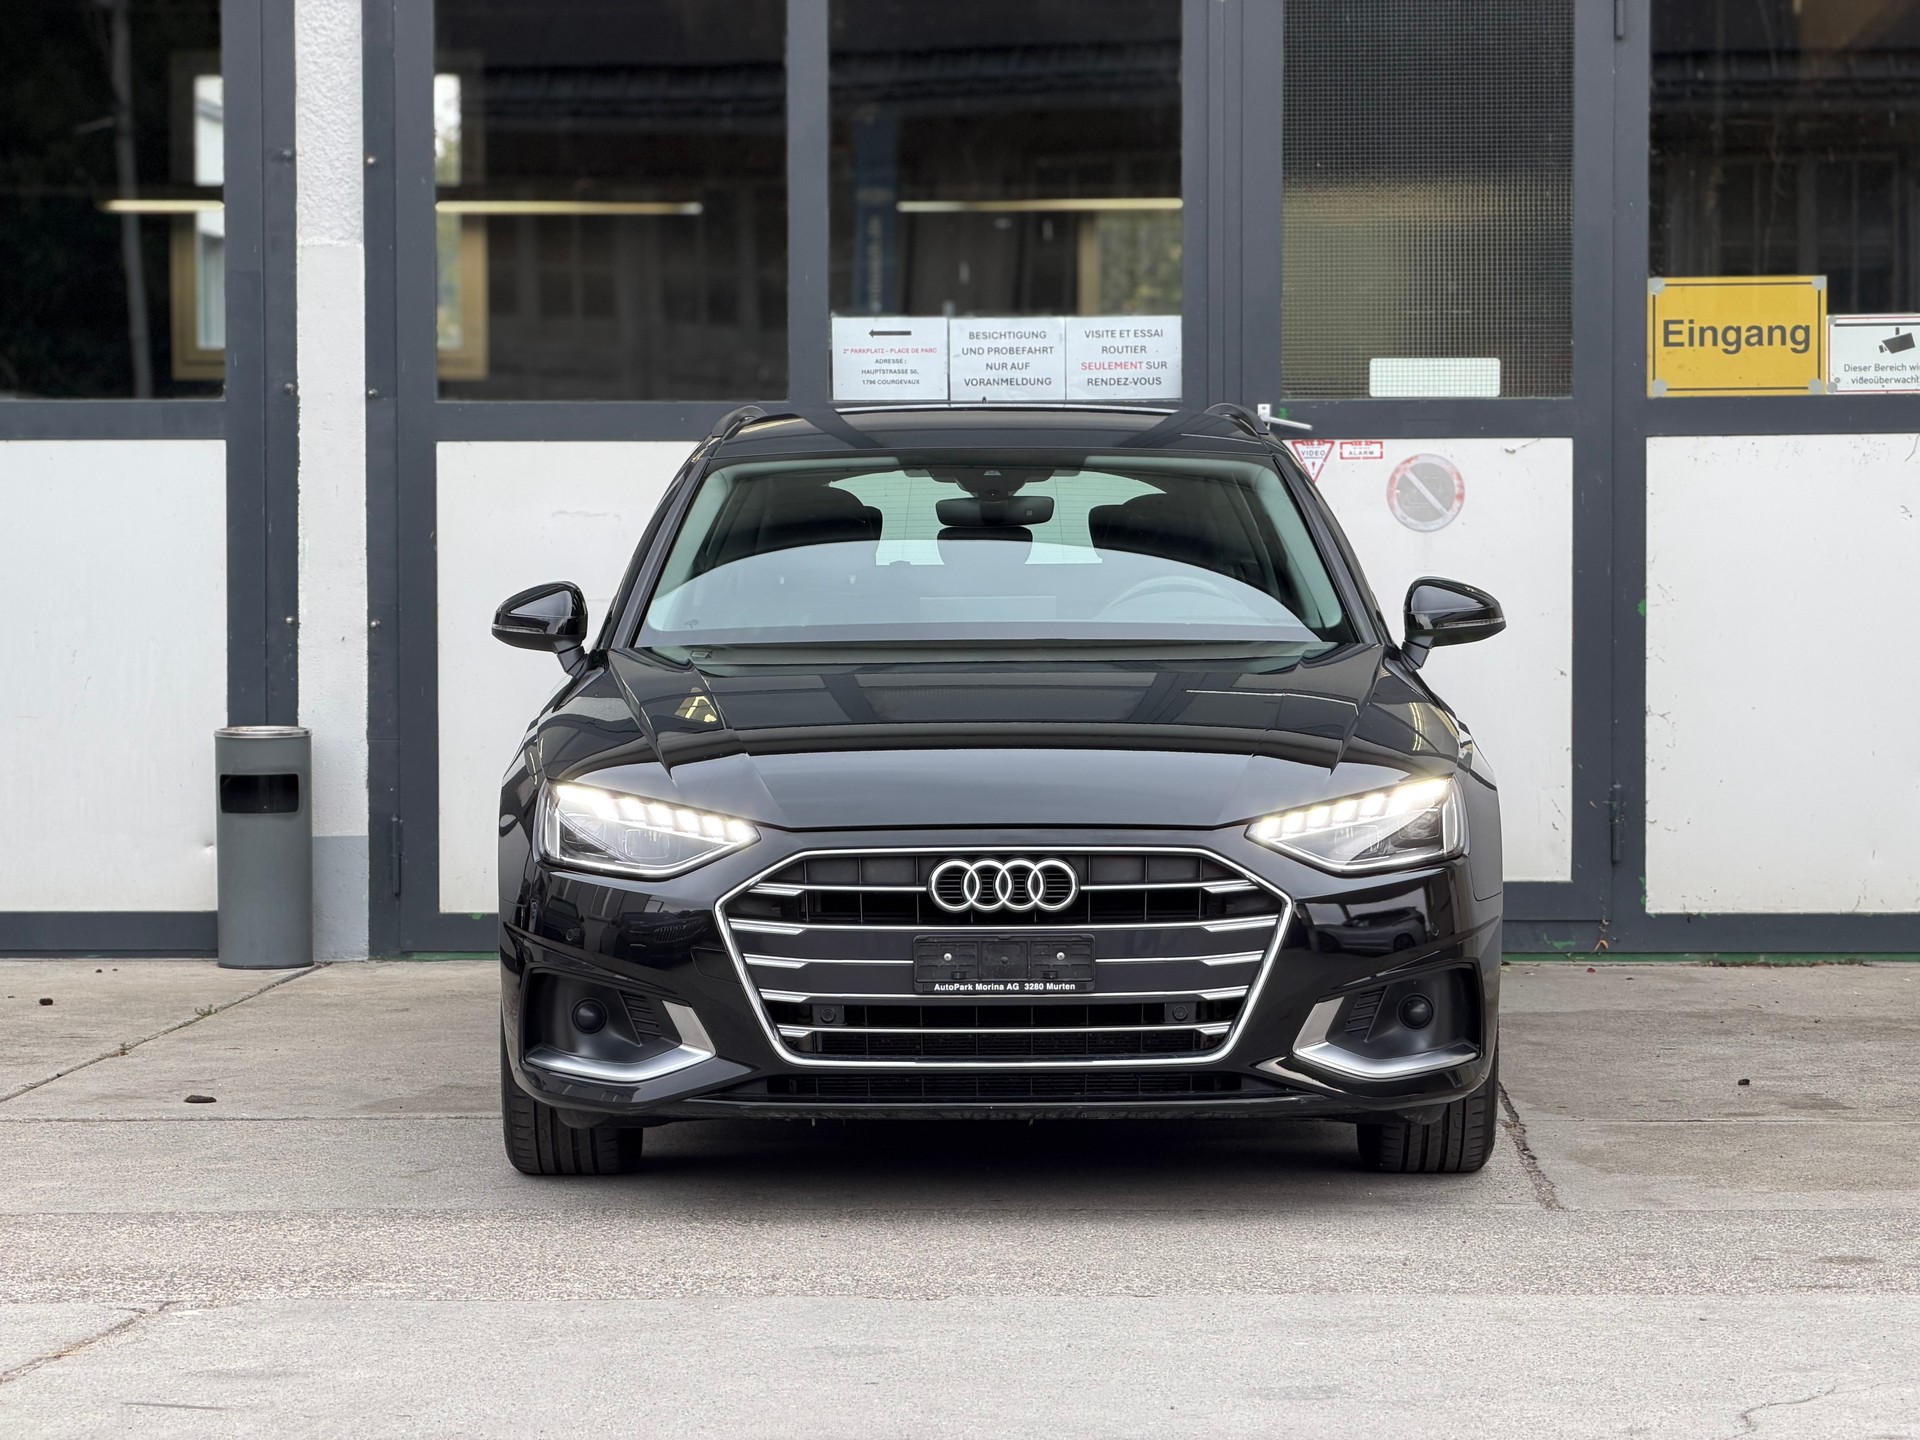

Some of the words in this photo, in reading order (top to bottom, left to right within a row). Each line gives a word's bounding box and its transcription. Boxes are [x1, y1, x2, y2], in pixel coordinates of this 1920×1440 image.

[968, 330, 1047, 340] BESICHTIGUNG
[1084, 329, 1117, 339] VISITE
[1119, 329, 1131, 338] ET
[1133, 329, 1163, 338] ESSAI
[1663, 319, 1810, 354] Eingang
[961, 347, 985, 356] UND
[987, 346, 1054, 355] PROBEFAHRT
[1101, 345, 1147, 354] ROUTIER
[985, 362, 1008, 371] NUR
[1009, 362, 1030, 370] AUF
[1080, 361, 1143, 370] SEULEMENT
[1145, 360, 1168, 370] SUR
[1843, 363, 1872, 372] Dieser
[1874, 363, 1907, 372] Bereich
[1909, 362, 1920, 371] wi
[963, 377, 1053, 387] VORANMELDUNG
[1087, 376, 1162, 386] RENDEZ-VOUS
[1851, 374, 1919, 384] videoüberwacht
[934, 983, 973, 991] AutoPark
[975, 983, 1004, 991] Morina
[1046, 983, 1076, 991] Murten
